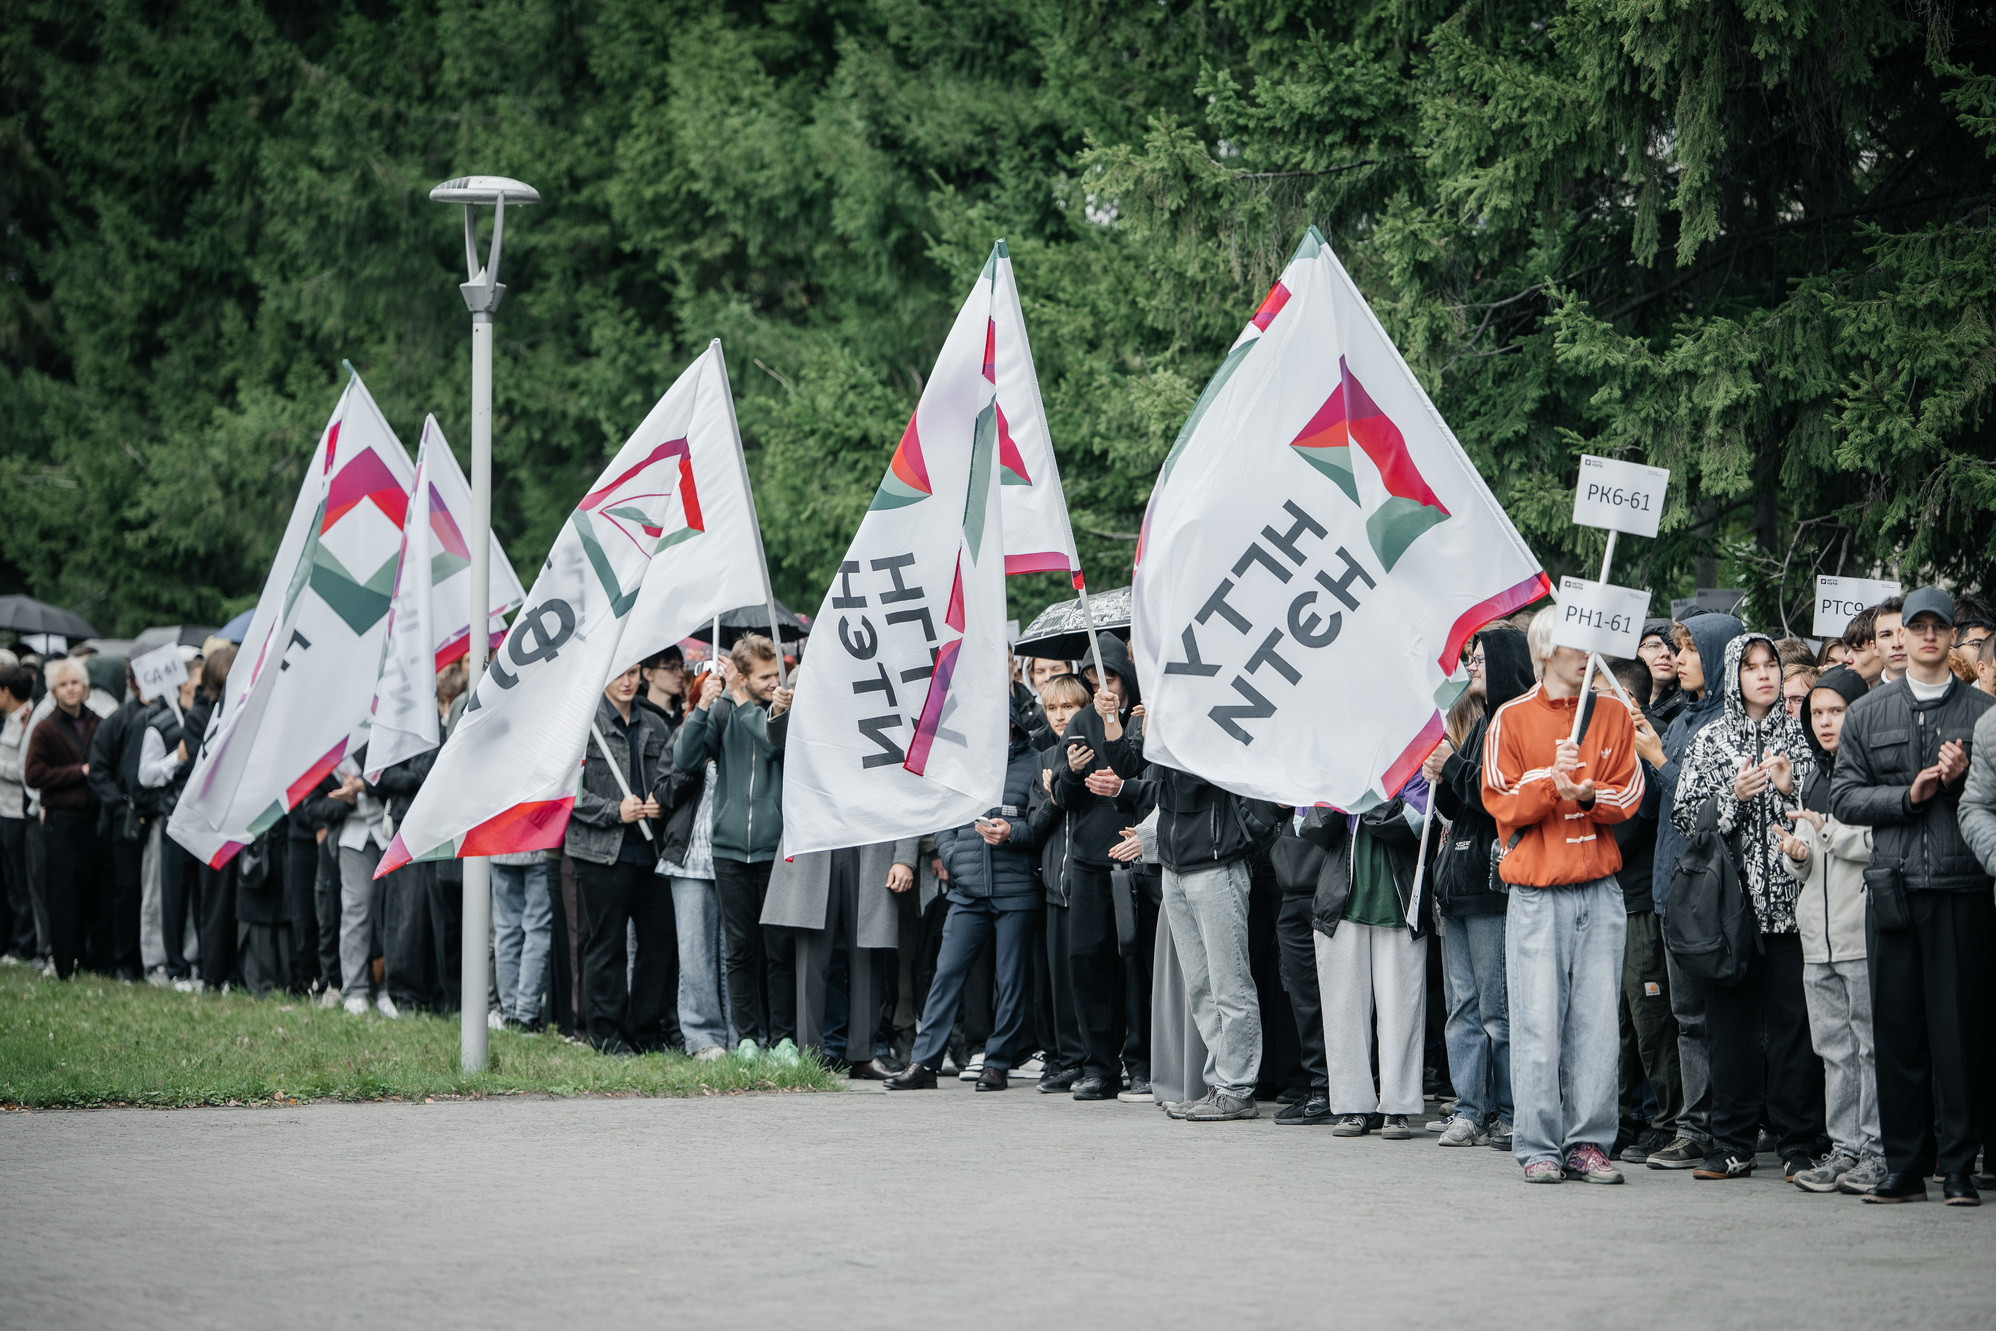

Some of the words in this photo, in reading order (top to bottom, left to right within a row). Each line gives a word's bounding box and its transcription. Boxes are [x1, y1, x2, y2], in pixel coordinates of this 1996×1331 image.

[1587, 484, 1649, 511] РК6-61
[1566, 605, 1631, 634] РН1-61
[832, 560, 906, 769] НЭТИ
